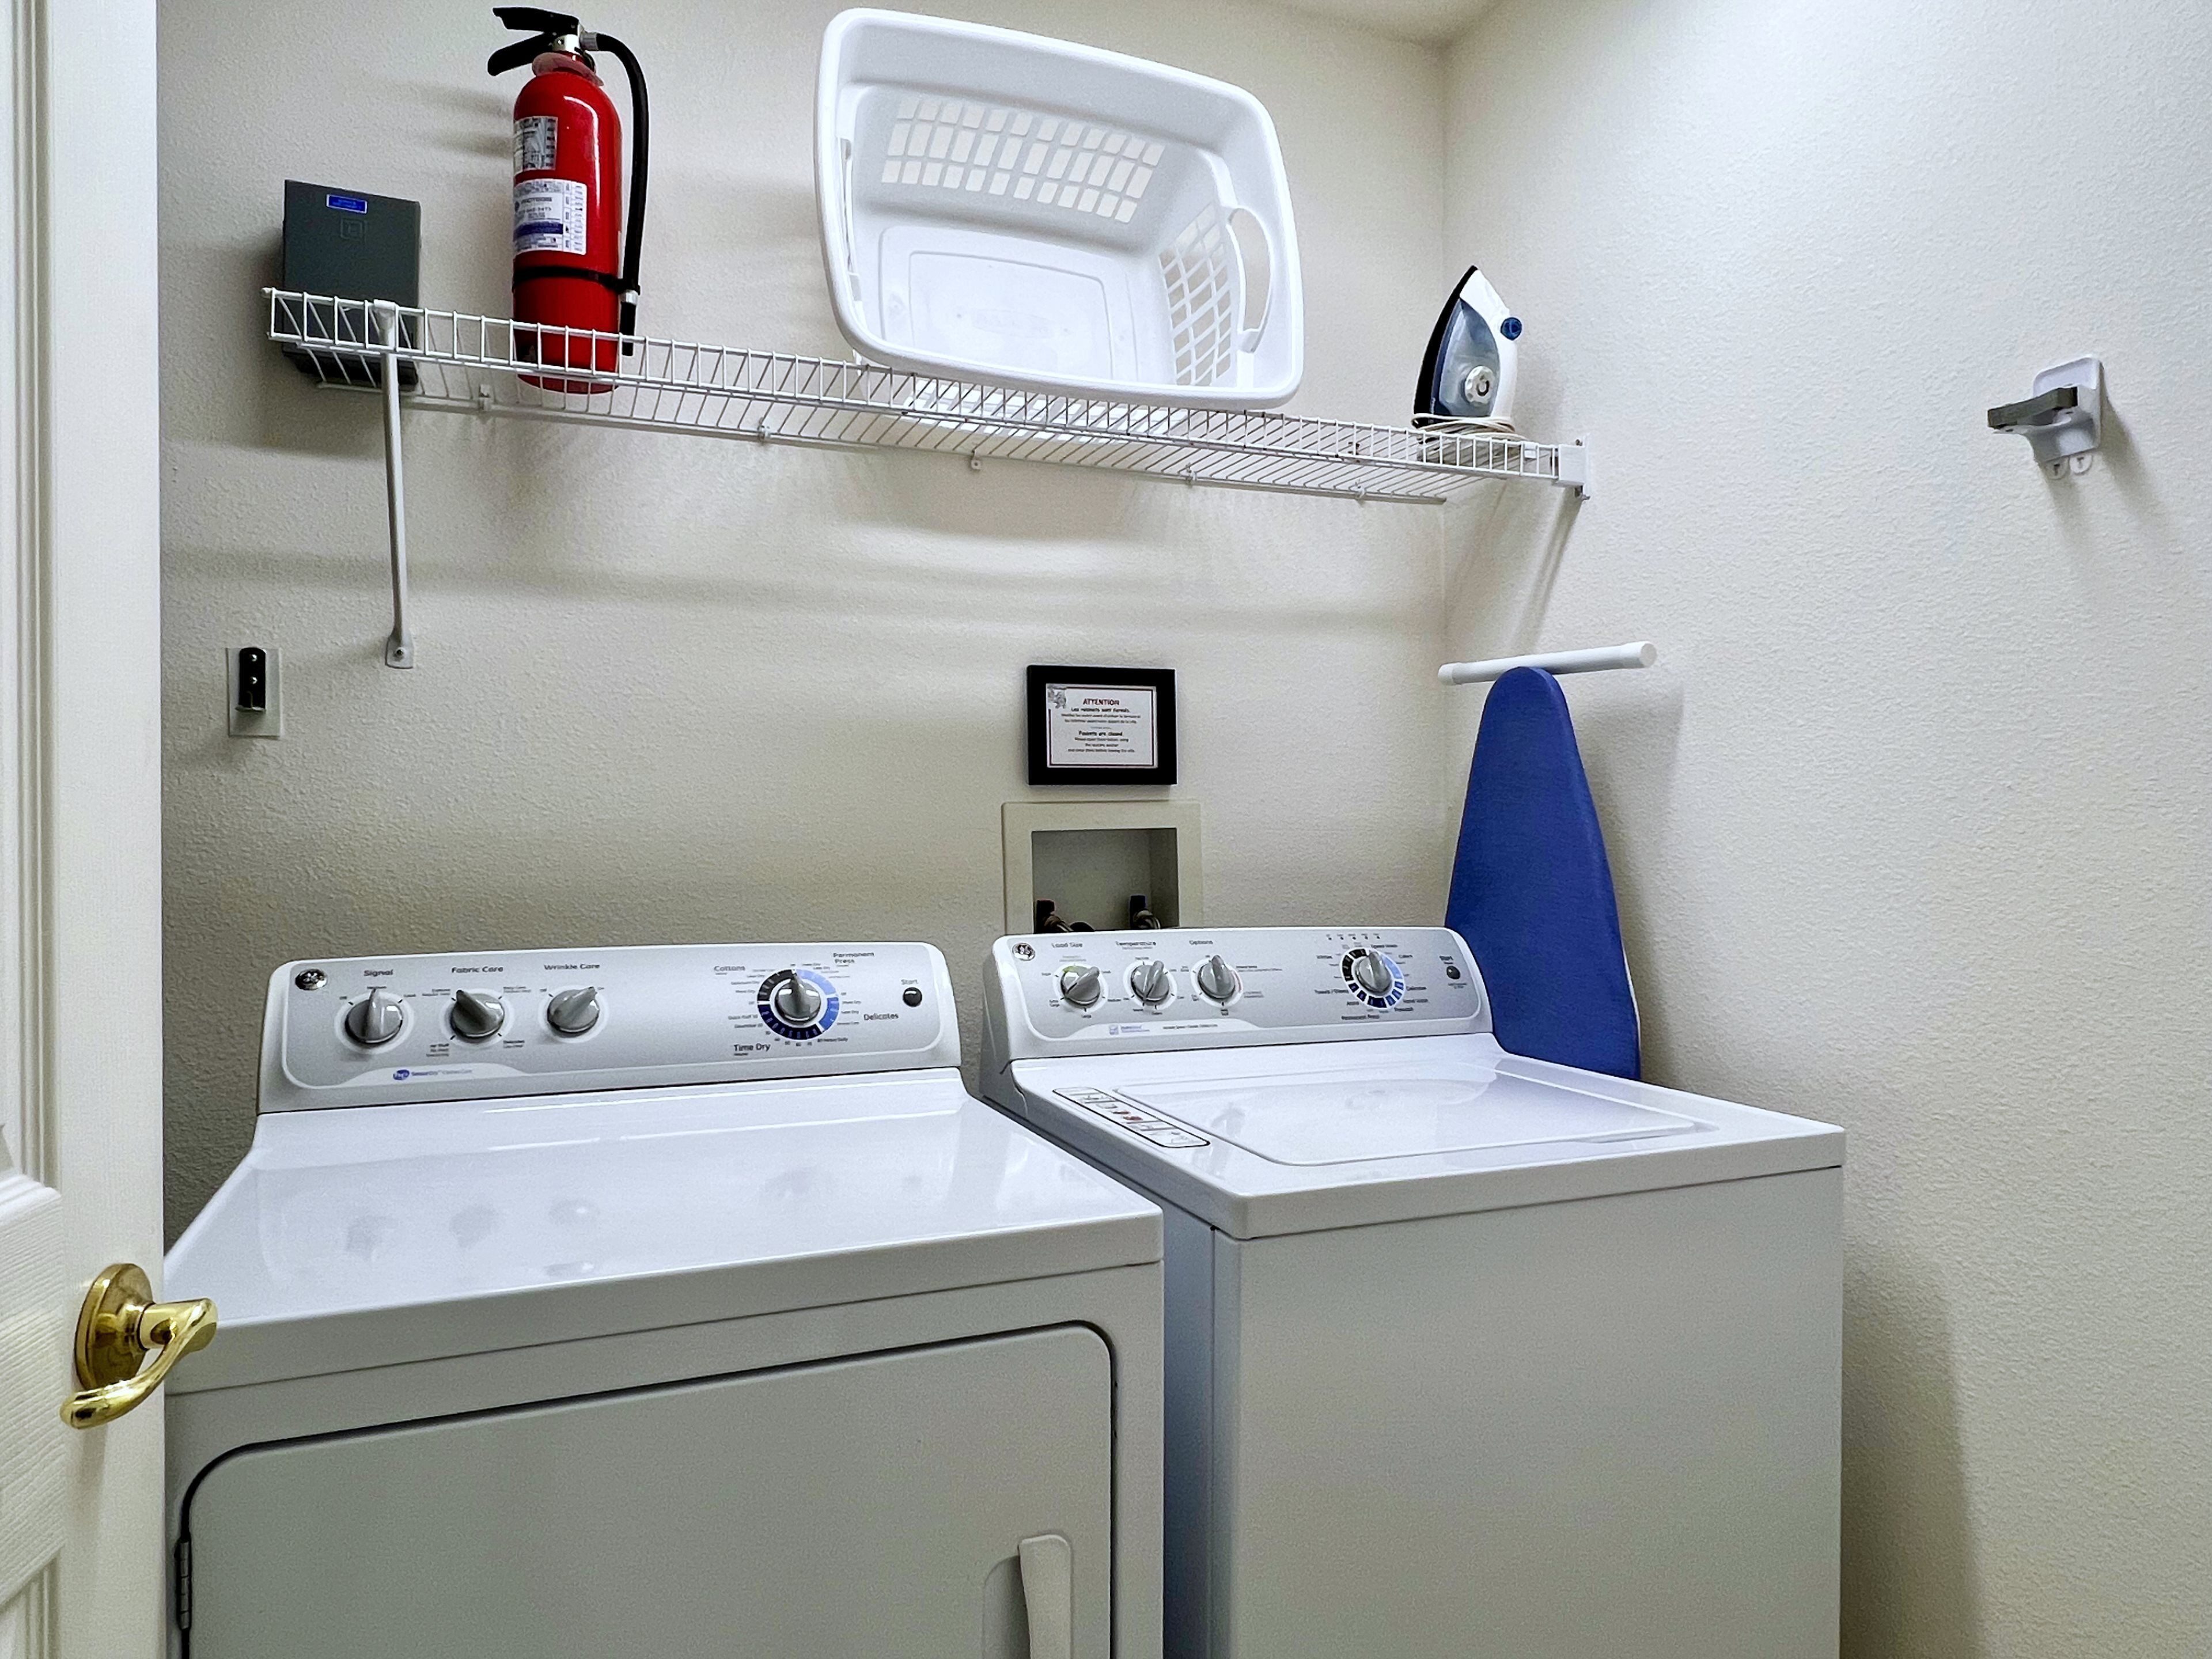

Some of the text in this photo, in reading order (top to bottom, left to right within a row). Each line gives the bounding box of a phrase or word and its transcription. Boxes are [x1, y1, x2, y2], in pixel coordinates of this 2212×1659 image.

[363, 969, 394, 978] Signal
[863, 1013, 899, 1021] Delicates
[756, 1043, 771, 1051] Dry
